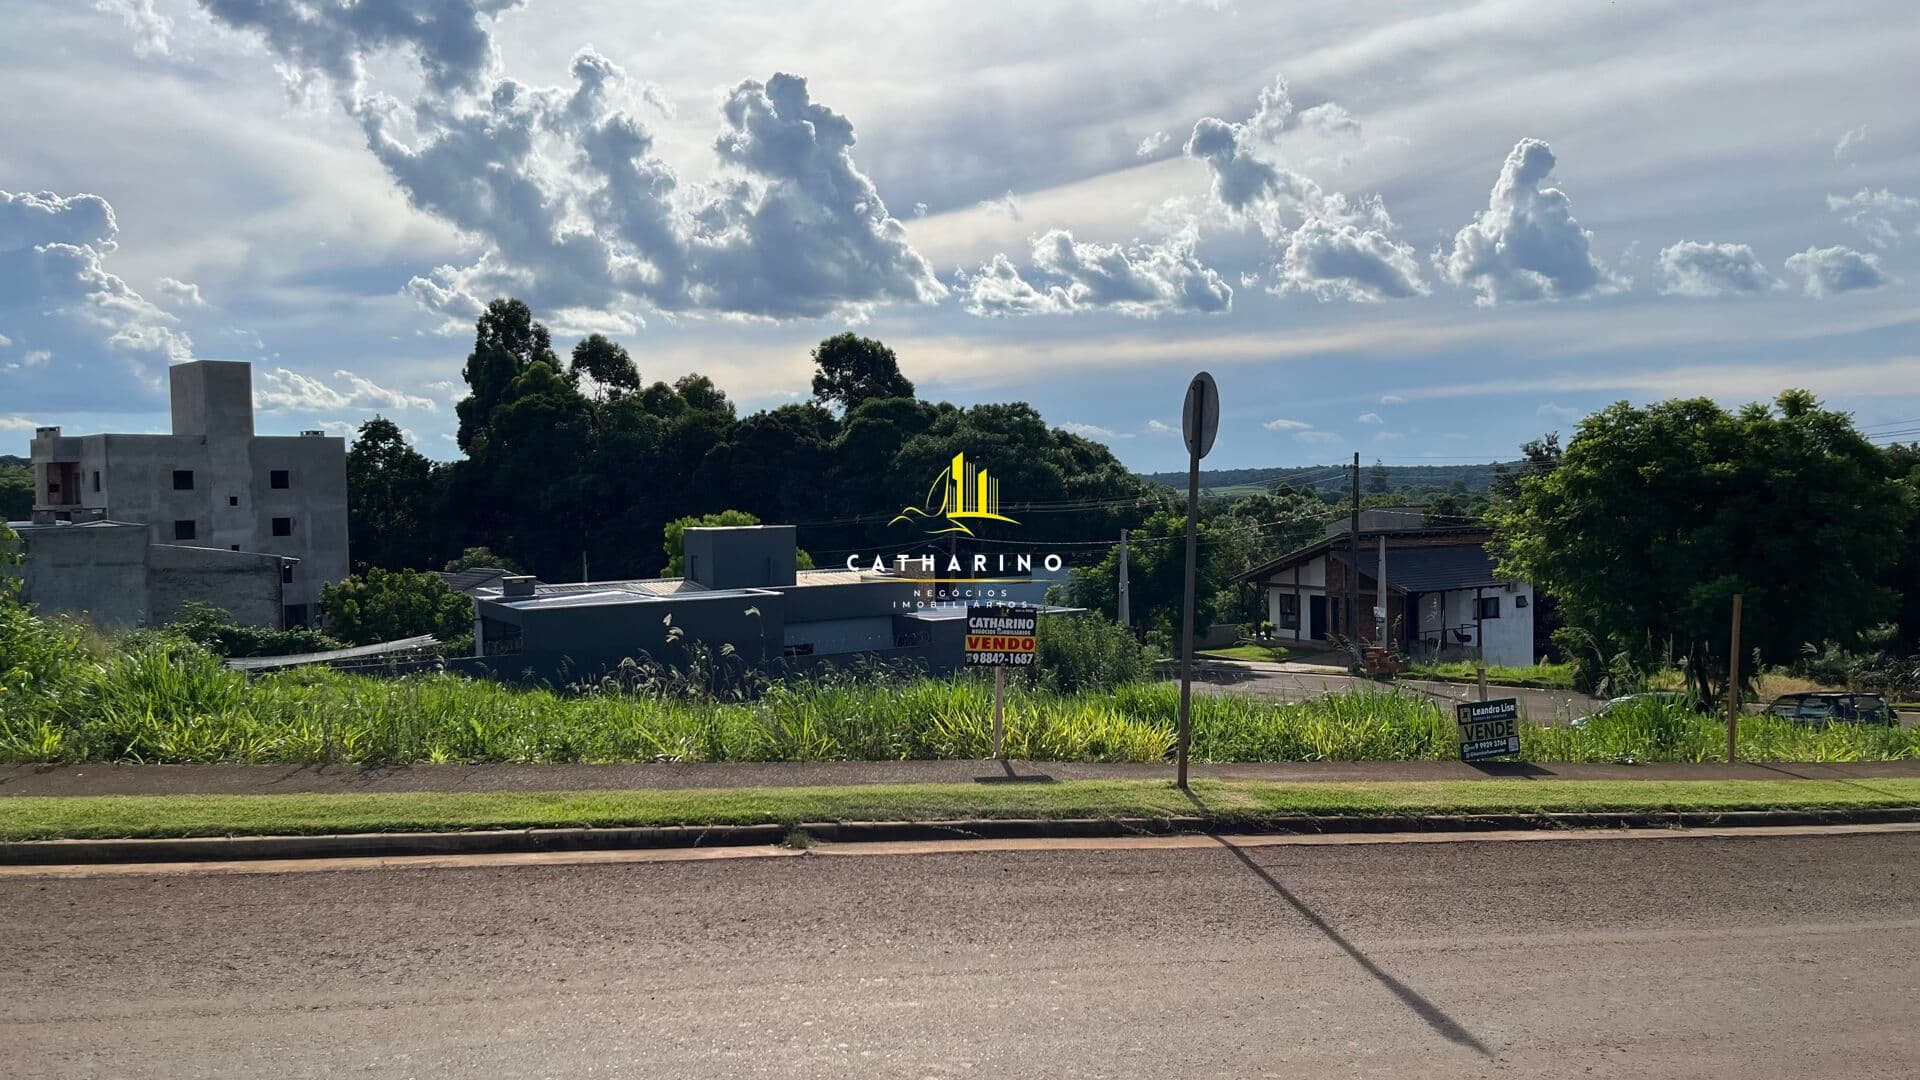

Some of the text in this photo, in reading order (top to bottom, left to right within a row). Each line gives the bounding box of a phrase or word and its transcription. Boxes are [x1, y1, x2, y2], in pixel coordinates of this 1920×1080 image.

[969, 617, 1035, 629] CATHARINO
[967, 636, 1035, 651] VENDO
[1472, 703, 1515, 716] Leandro Lise
[1464, 719, 1515, 741] VENDE
